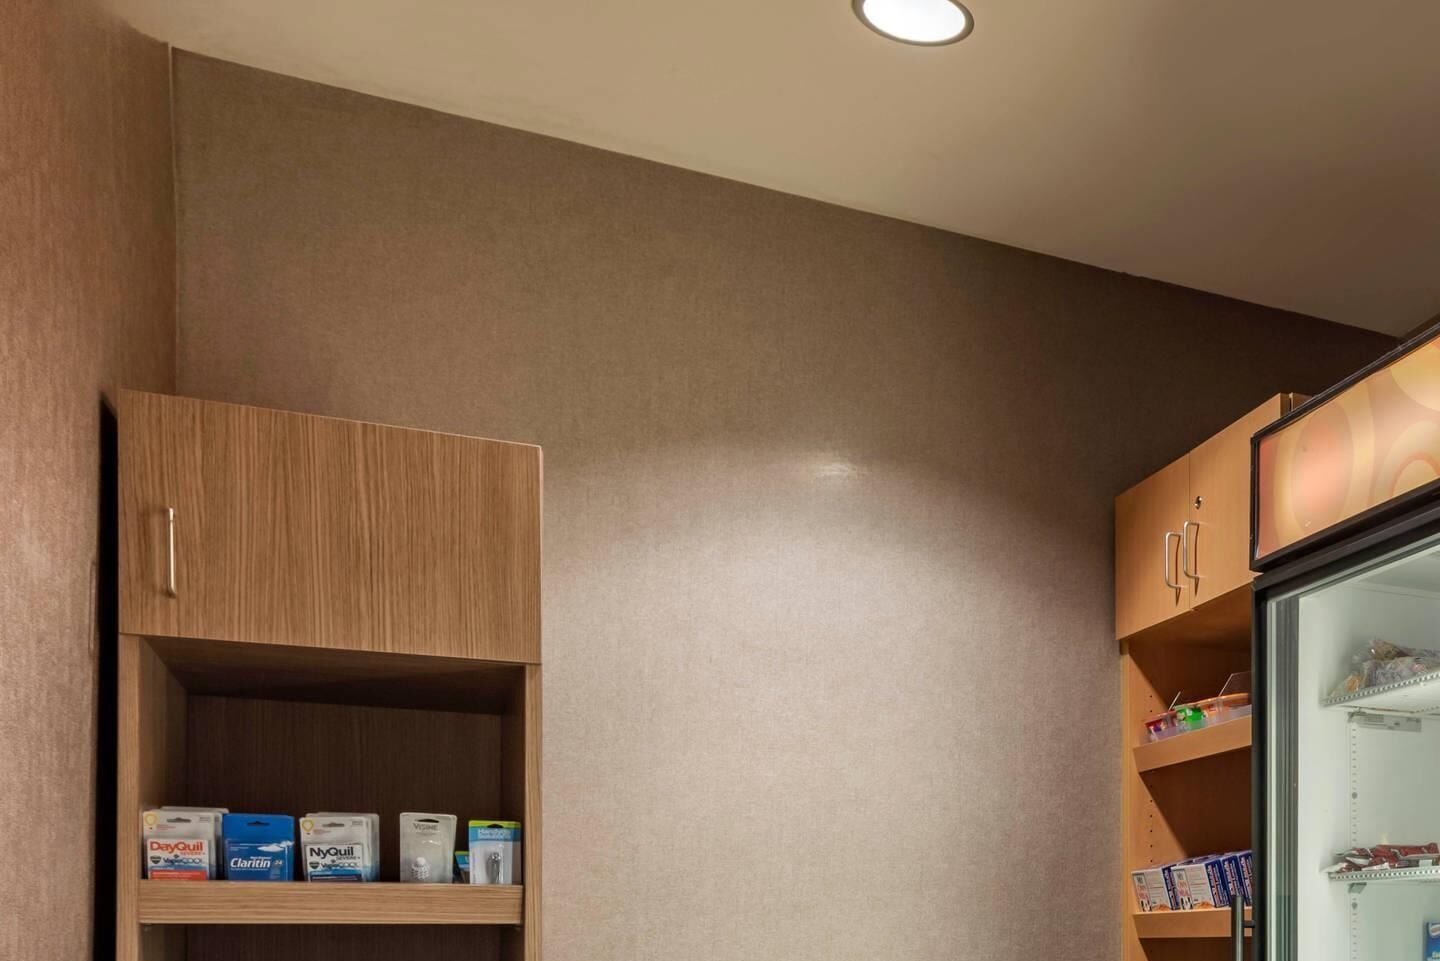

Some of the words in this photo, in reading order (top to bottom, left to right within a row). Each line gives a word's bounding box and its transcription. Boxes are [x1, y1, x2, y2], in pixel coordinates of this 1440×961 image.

[150, 841, 203, 854] DayQuil
[309, 846, 354, 859] NyQuil
[230, 857, 271, 869] Claritin
